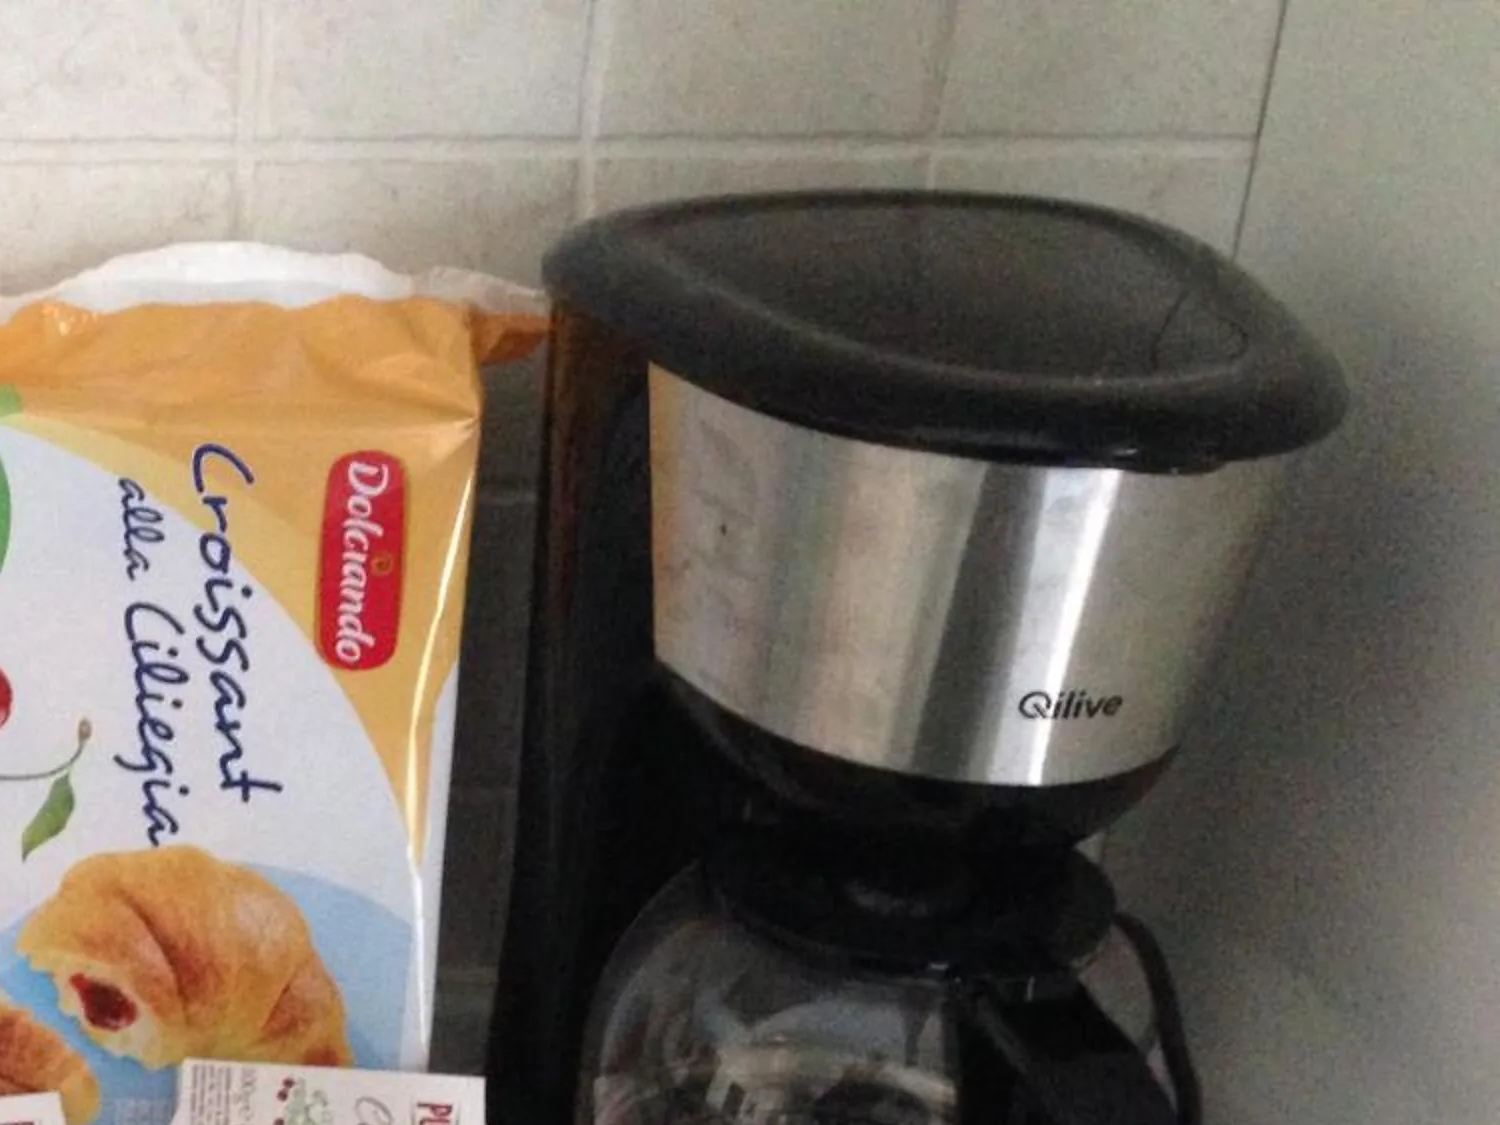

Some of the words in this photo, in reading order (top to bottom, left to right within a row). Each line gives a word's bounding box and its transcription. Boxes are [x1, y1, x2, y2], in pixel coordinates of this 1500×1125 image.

[118, 477, 164, 582] alla
[191, 443, 284, 804] Croissant
[332, 461, 389, 665] Dolciando
[113, 601, 191, 848] Ciliegia
[1018, 690, 1124, 720] Qilive
